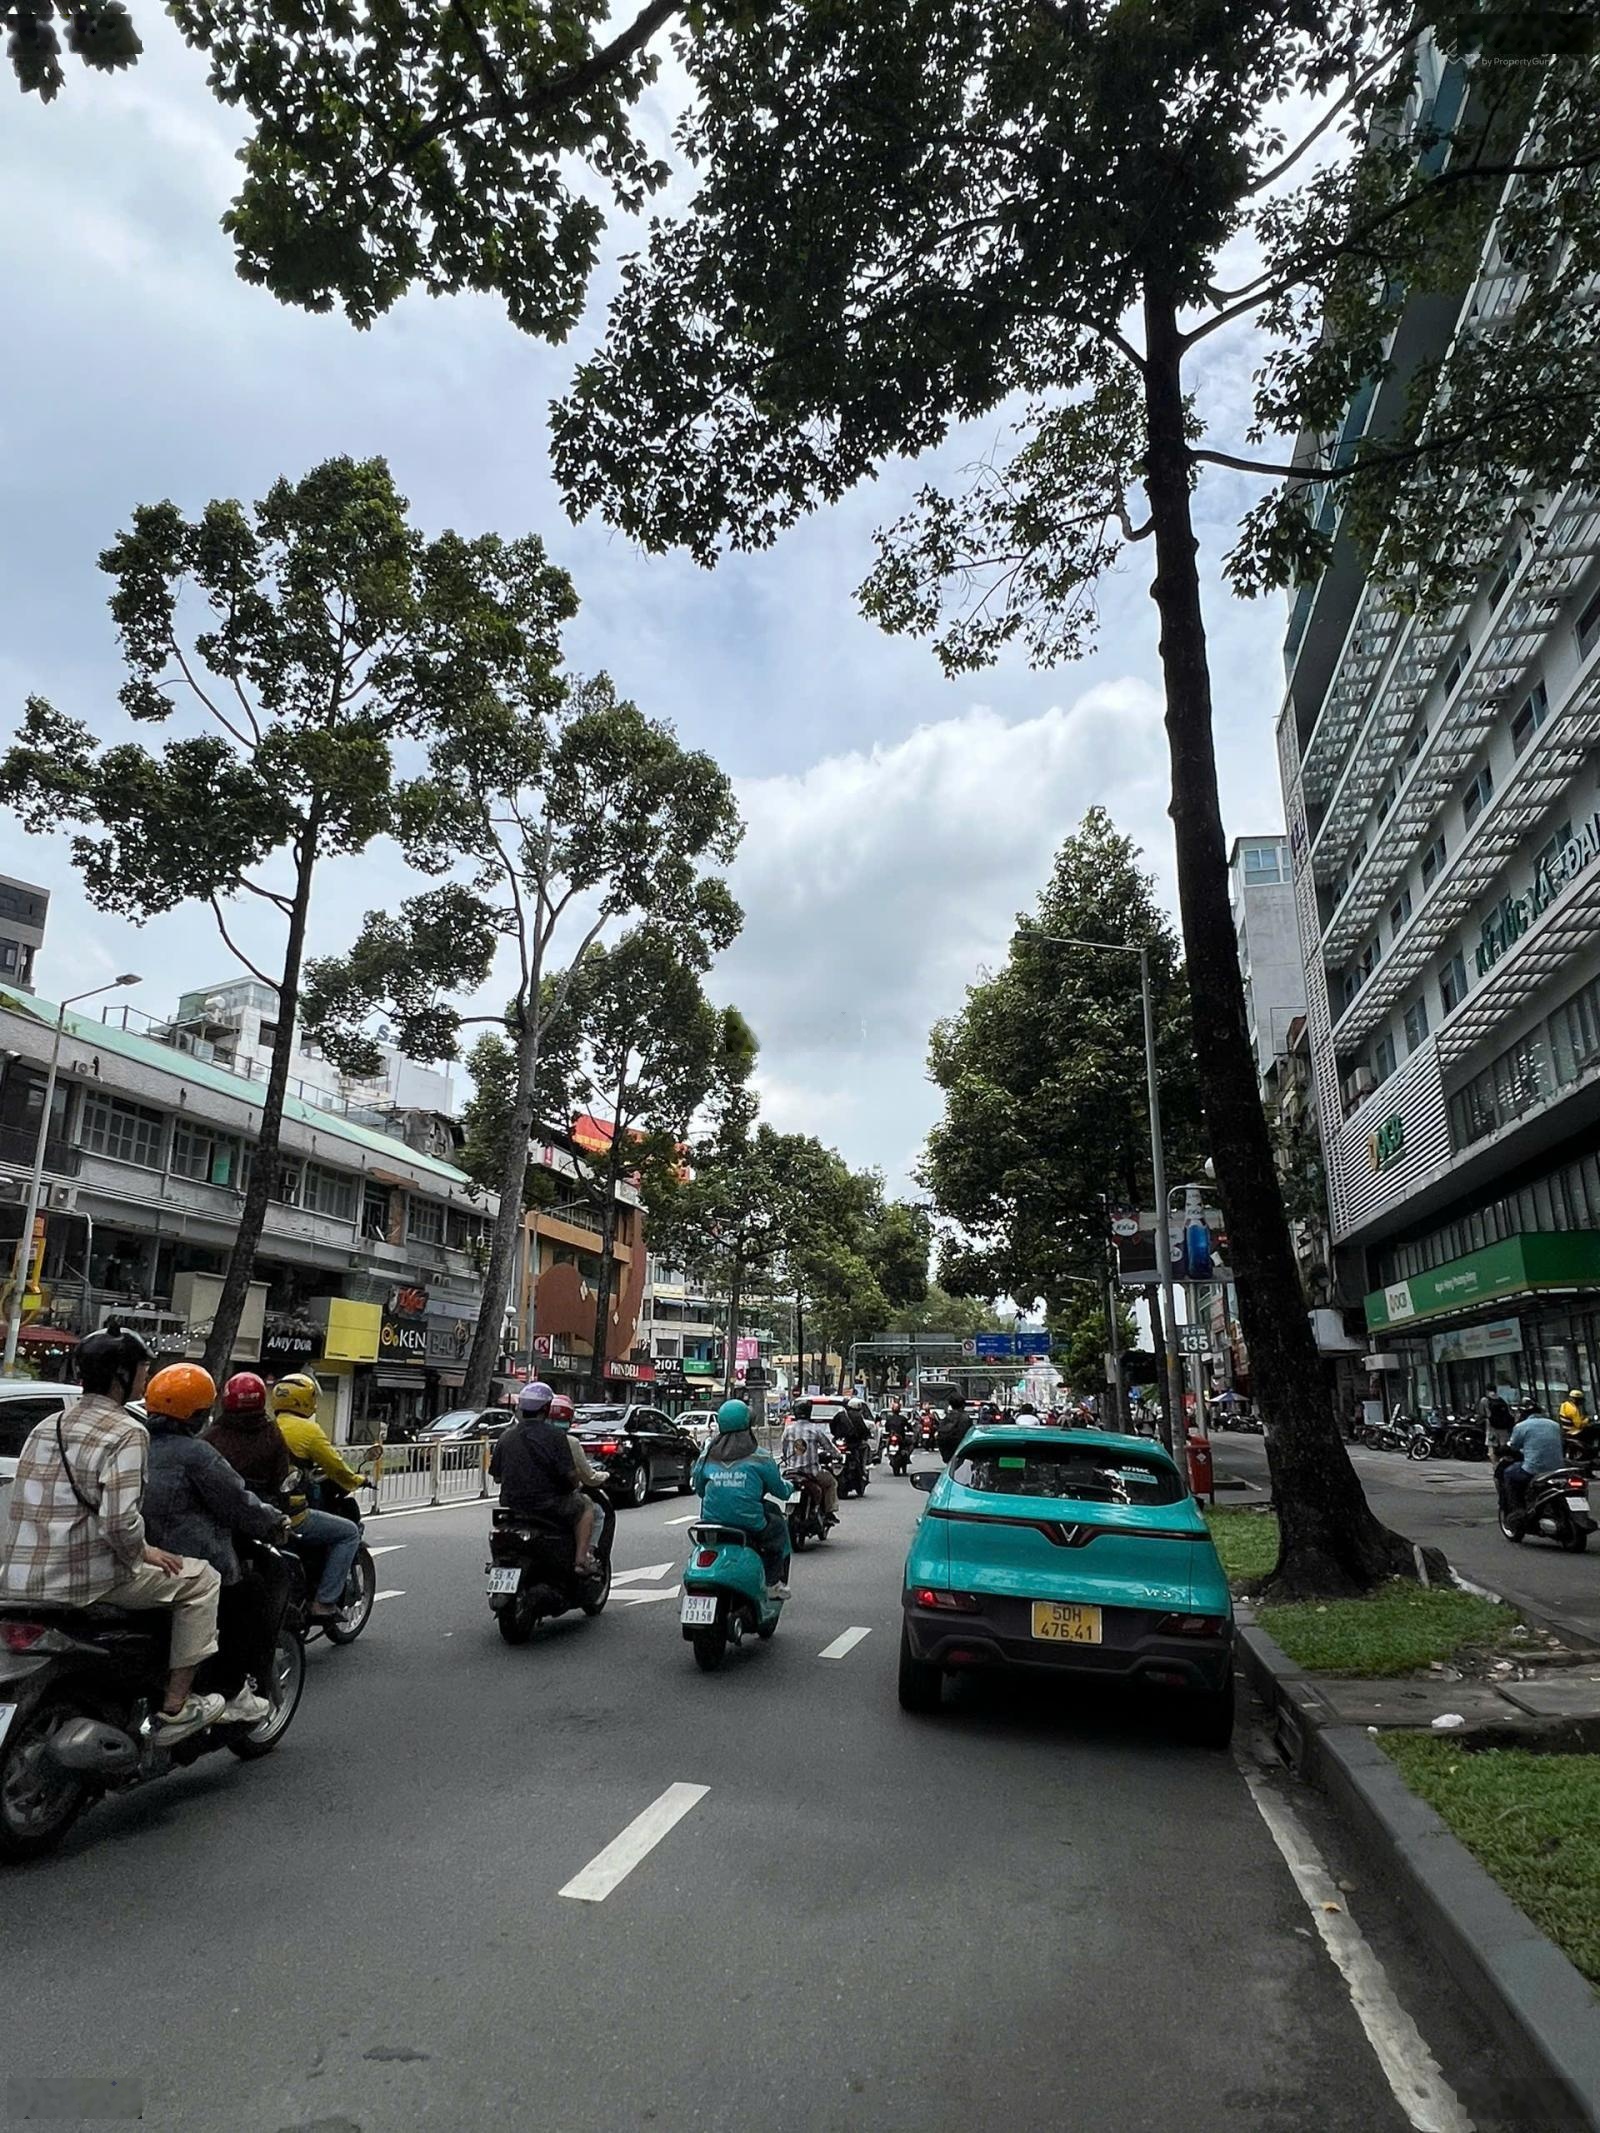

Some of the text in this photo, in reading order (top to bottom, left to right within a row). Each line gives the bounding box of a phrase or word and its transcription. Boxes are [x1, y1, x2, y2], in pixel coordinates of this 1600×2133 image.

[1180, 1336, 1209, 1351] 135
[1052, 1605, 1082, 1622] 50H
[1041, 1622, 1092, 1640] 476.41
